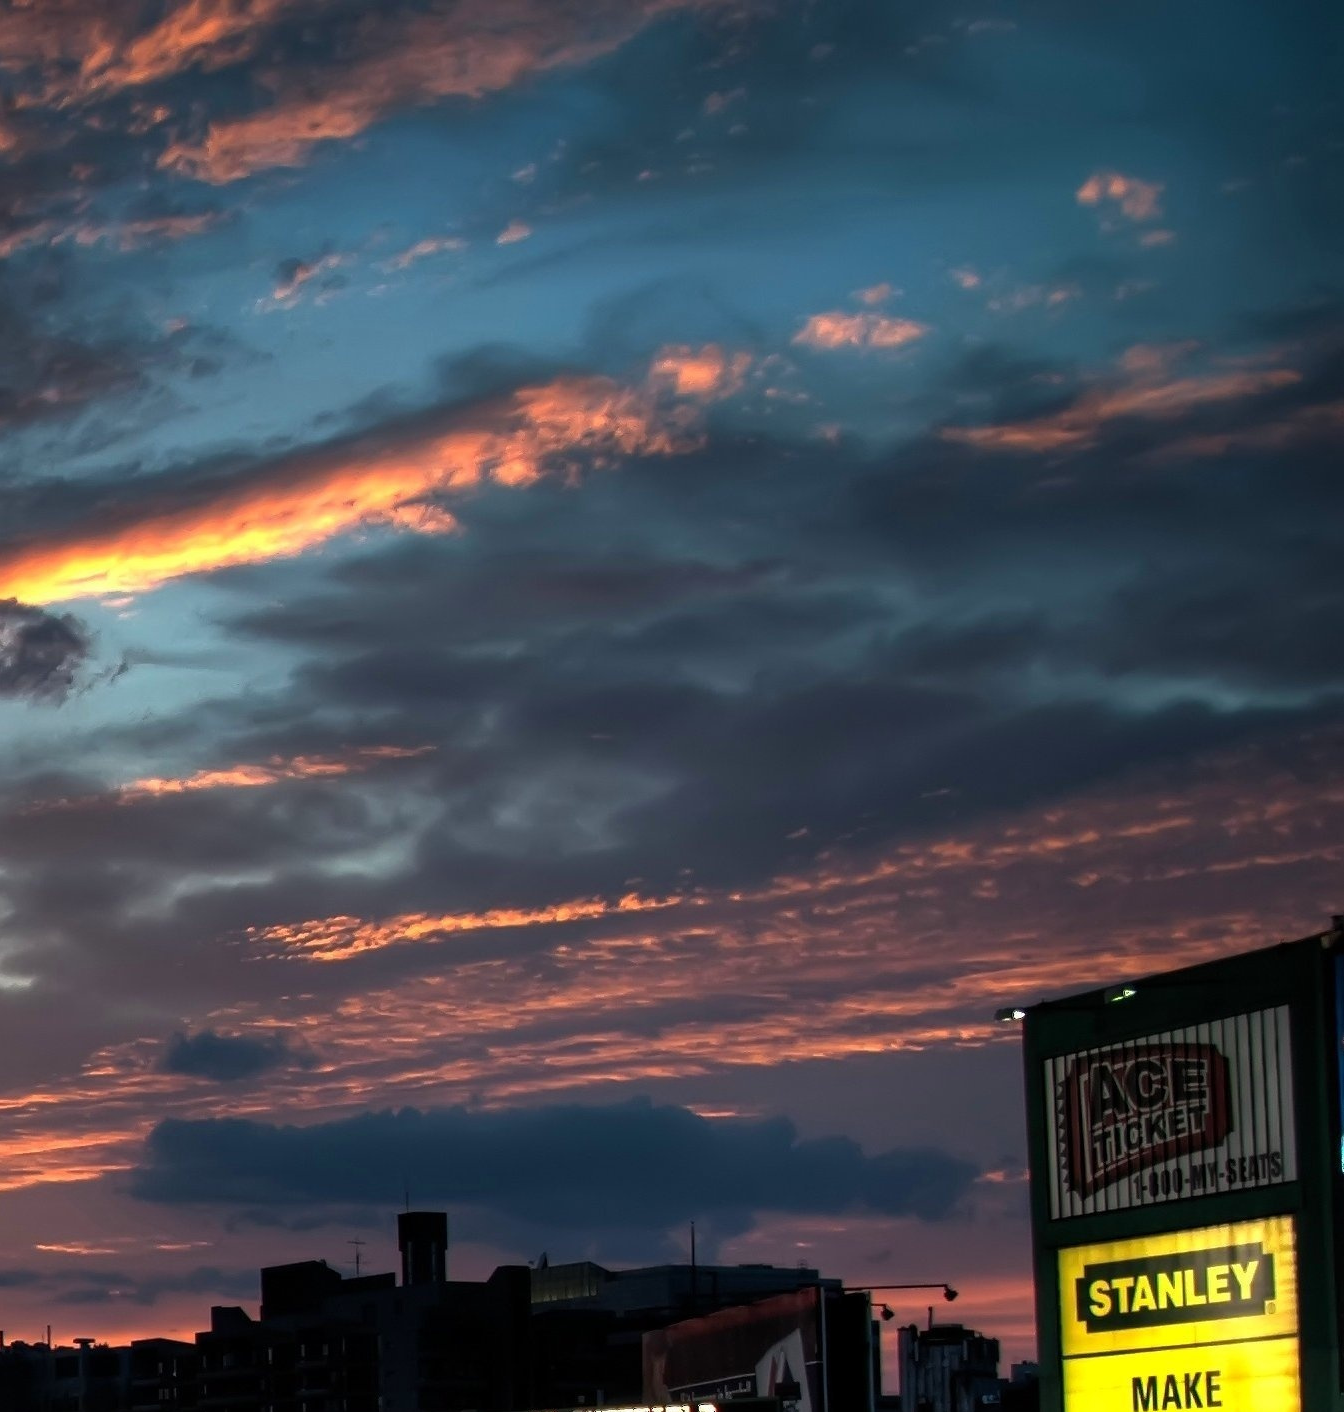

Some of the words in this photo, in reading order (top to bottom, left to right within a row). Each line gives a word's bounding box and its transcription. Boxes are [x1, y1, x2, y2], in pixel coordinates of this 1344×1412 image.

[1090, 1057, 1209, 1130] ACE
[1093, 1104, 1207, 1169] TICKET
[1132, 1151, 1283, 1200] 1-800-MY-SEATS
[1088, 1260, 1259, 1318] STANLEY
[1132, 1370, 1223, 1412] MAKE
